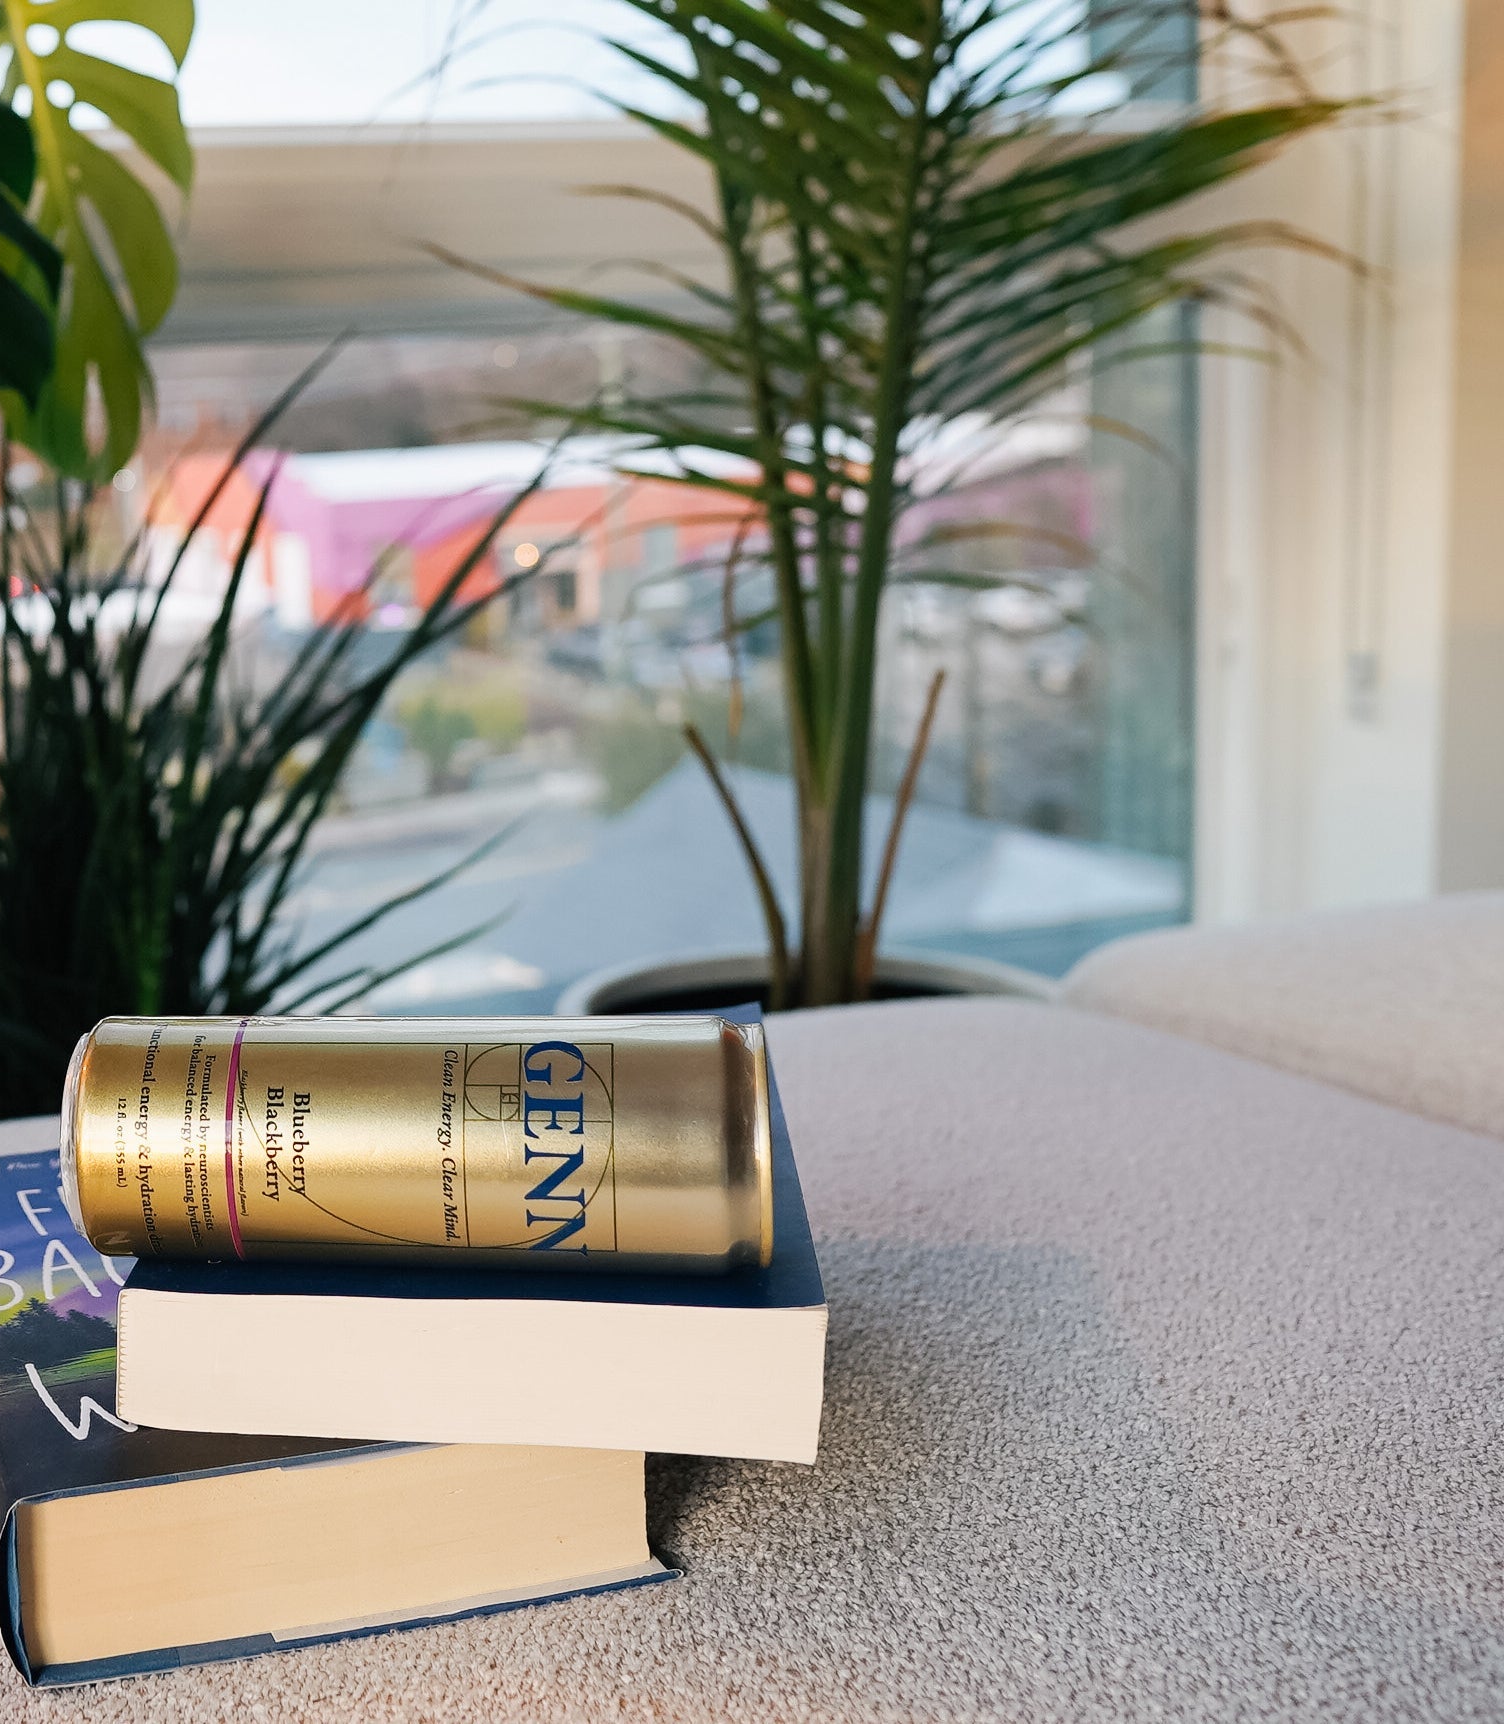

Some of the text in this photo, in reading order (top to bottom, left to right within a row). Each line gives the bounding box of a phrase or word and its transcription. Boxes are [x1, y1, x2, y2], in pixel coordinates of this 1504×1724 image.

[141, 1023, 169, 1084] Functional
[192, 1034, 207, 1047] for
[186, 1048, 203, 1097] balanced
[118, 1097, 127, 1110] 12
[135, 1086, 150, 1140] energy
[181, 1099, 193, 1143] energy
[115, 1140, 126, 1165] (355
[116, 1125, 124, 1138] oz
[138, 1144, 152, 1160] &
[183, 1146, 195, 1159] &
[196, 1054, 217, 1231] Formulated by neuroscientists
[261, 1086, 284, 1202] Blackberry
[287, 1092, 311, 1197] Blueberry
[437, 1049, 461, 1242] Clean Energy. Clear Mind.
[116, 1167, 129, 1188] mL)
[136, 1164, 158, 1232] hydration
[183, 1162, 196, 1203] lasting
